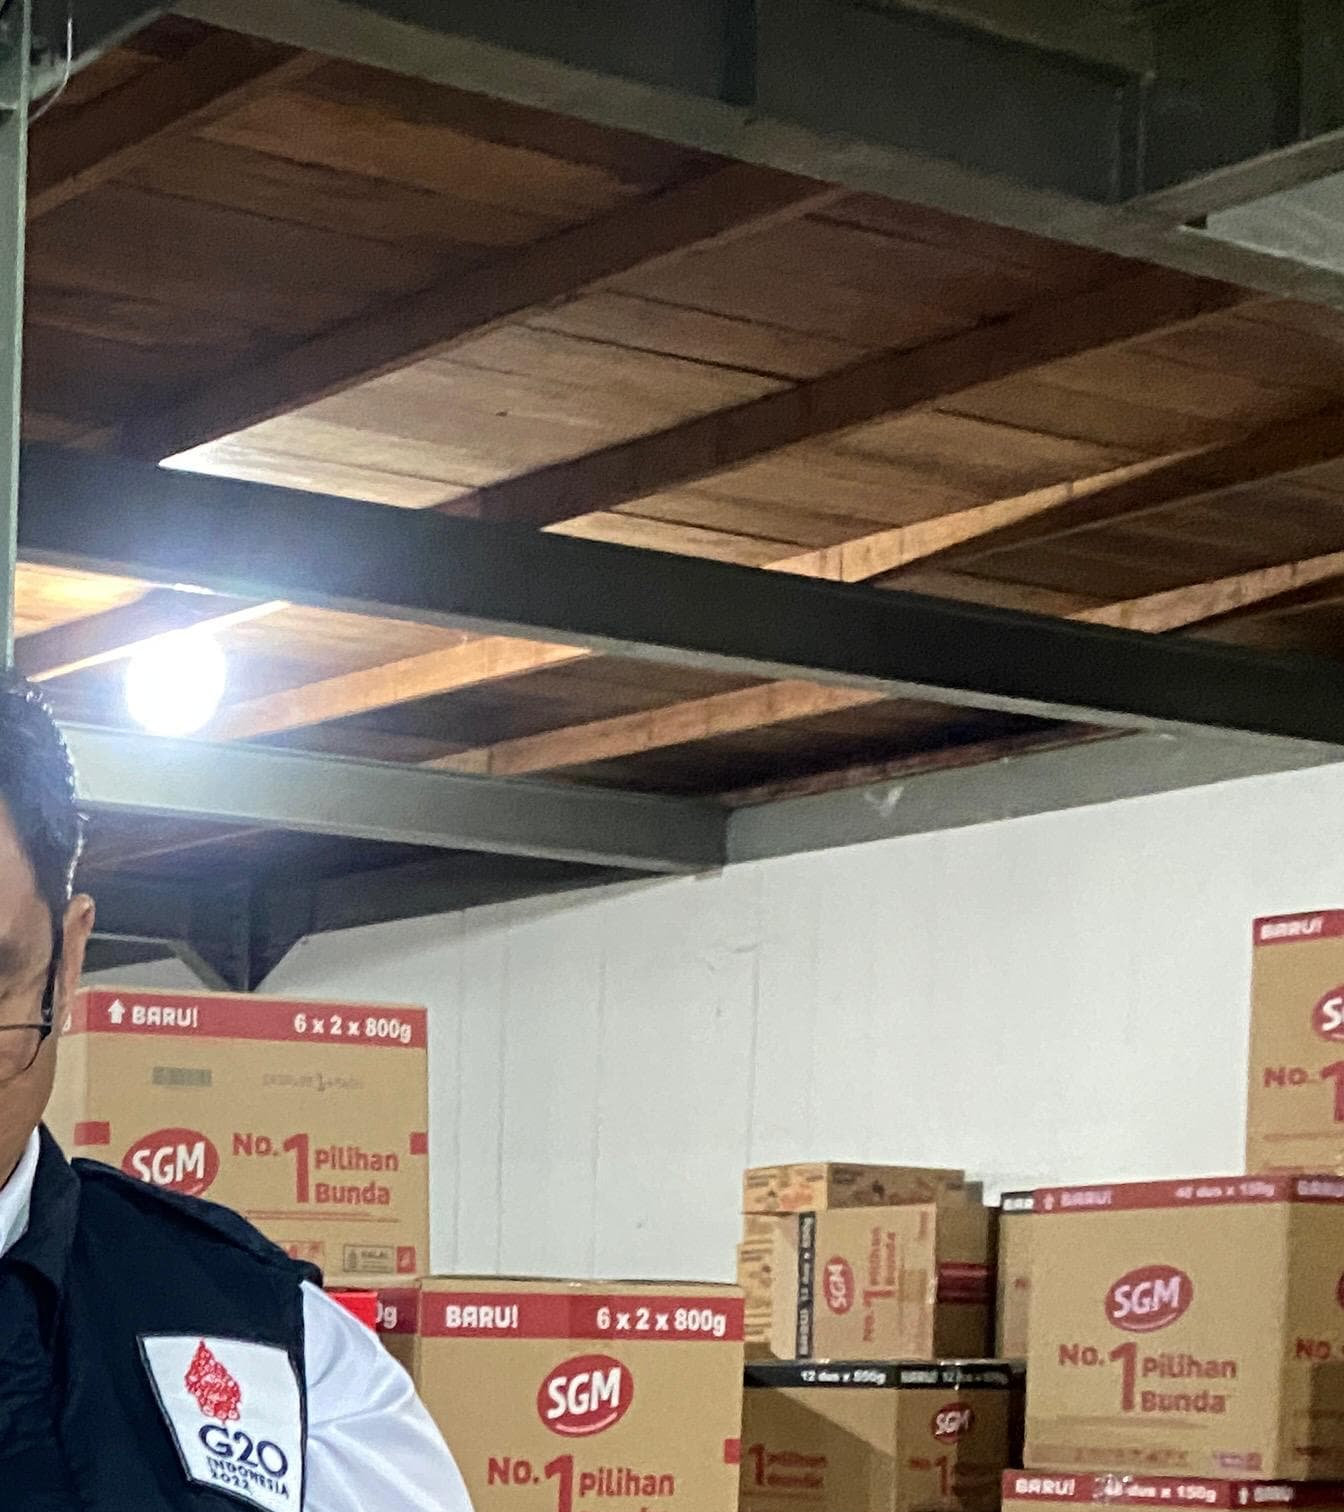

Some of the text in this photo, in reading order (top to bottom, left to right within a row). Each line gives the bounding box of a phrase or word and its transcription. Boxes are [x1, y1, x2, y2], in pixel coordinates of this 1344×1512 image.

[131, 1142, 206, 1185] SGM
[232, 1133, 400, 1204] No. 1 Pilihan
[828, 1264, 847, 1309] SGM
[1113, 1275, 1181, 1319] SGM
[446, 1304, 726, 1337] BARU! 6 x 2 x 800g
[546, 1367, 620, 1418] SGM
[1059, 1342, 1237, 1413] No. 1 Pilihan
[1141, 1390, 1226, 1414] Bunda
[198, 1424, 289, 1480] G20
[207, 1456, 290, 1499] INDONESIA
[212, 1471, 250, 1490] 2022
[488, 1458, 540, 1486] No.
[579, 1468, 675, 1497] Pilihan
